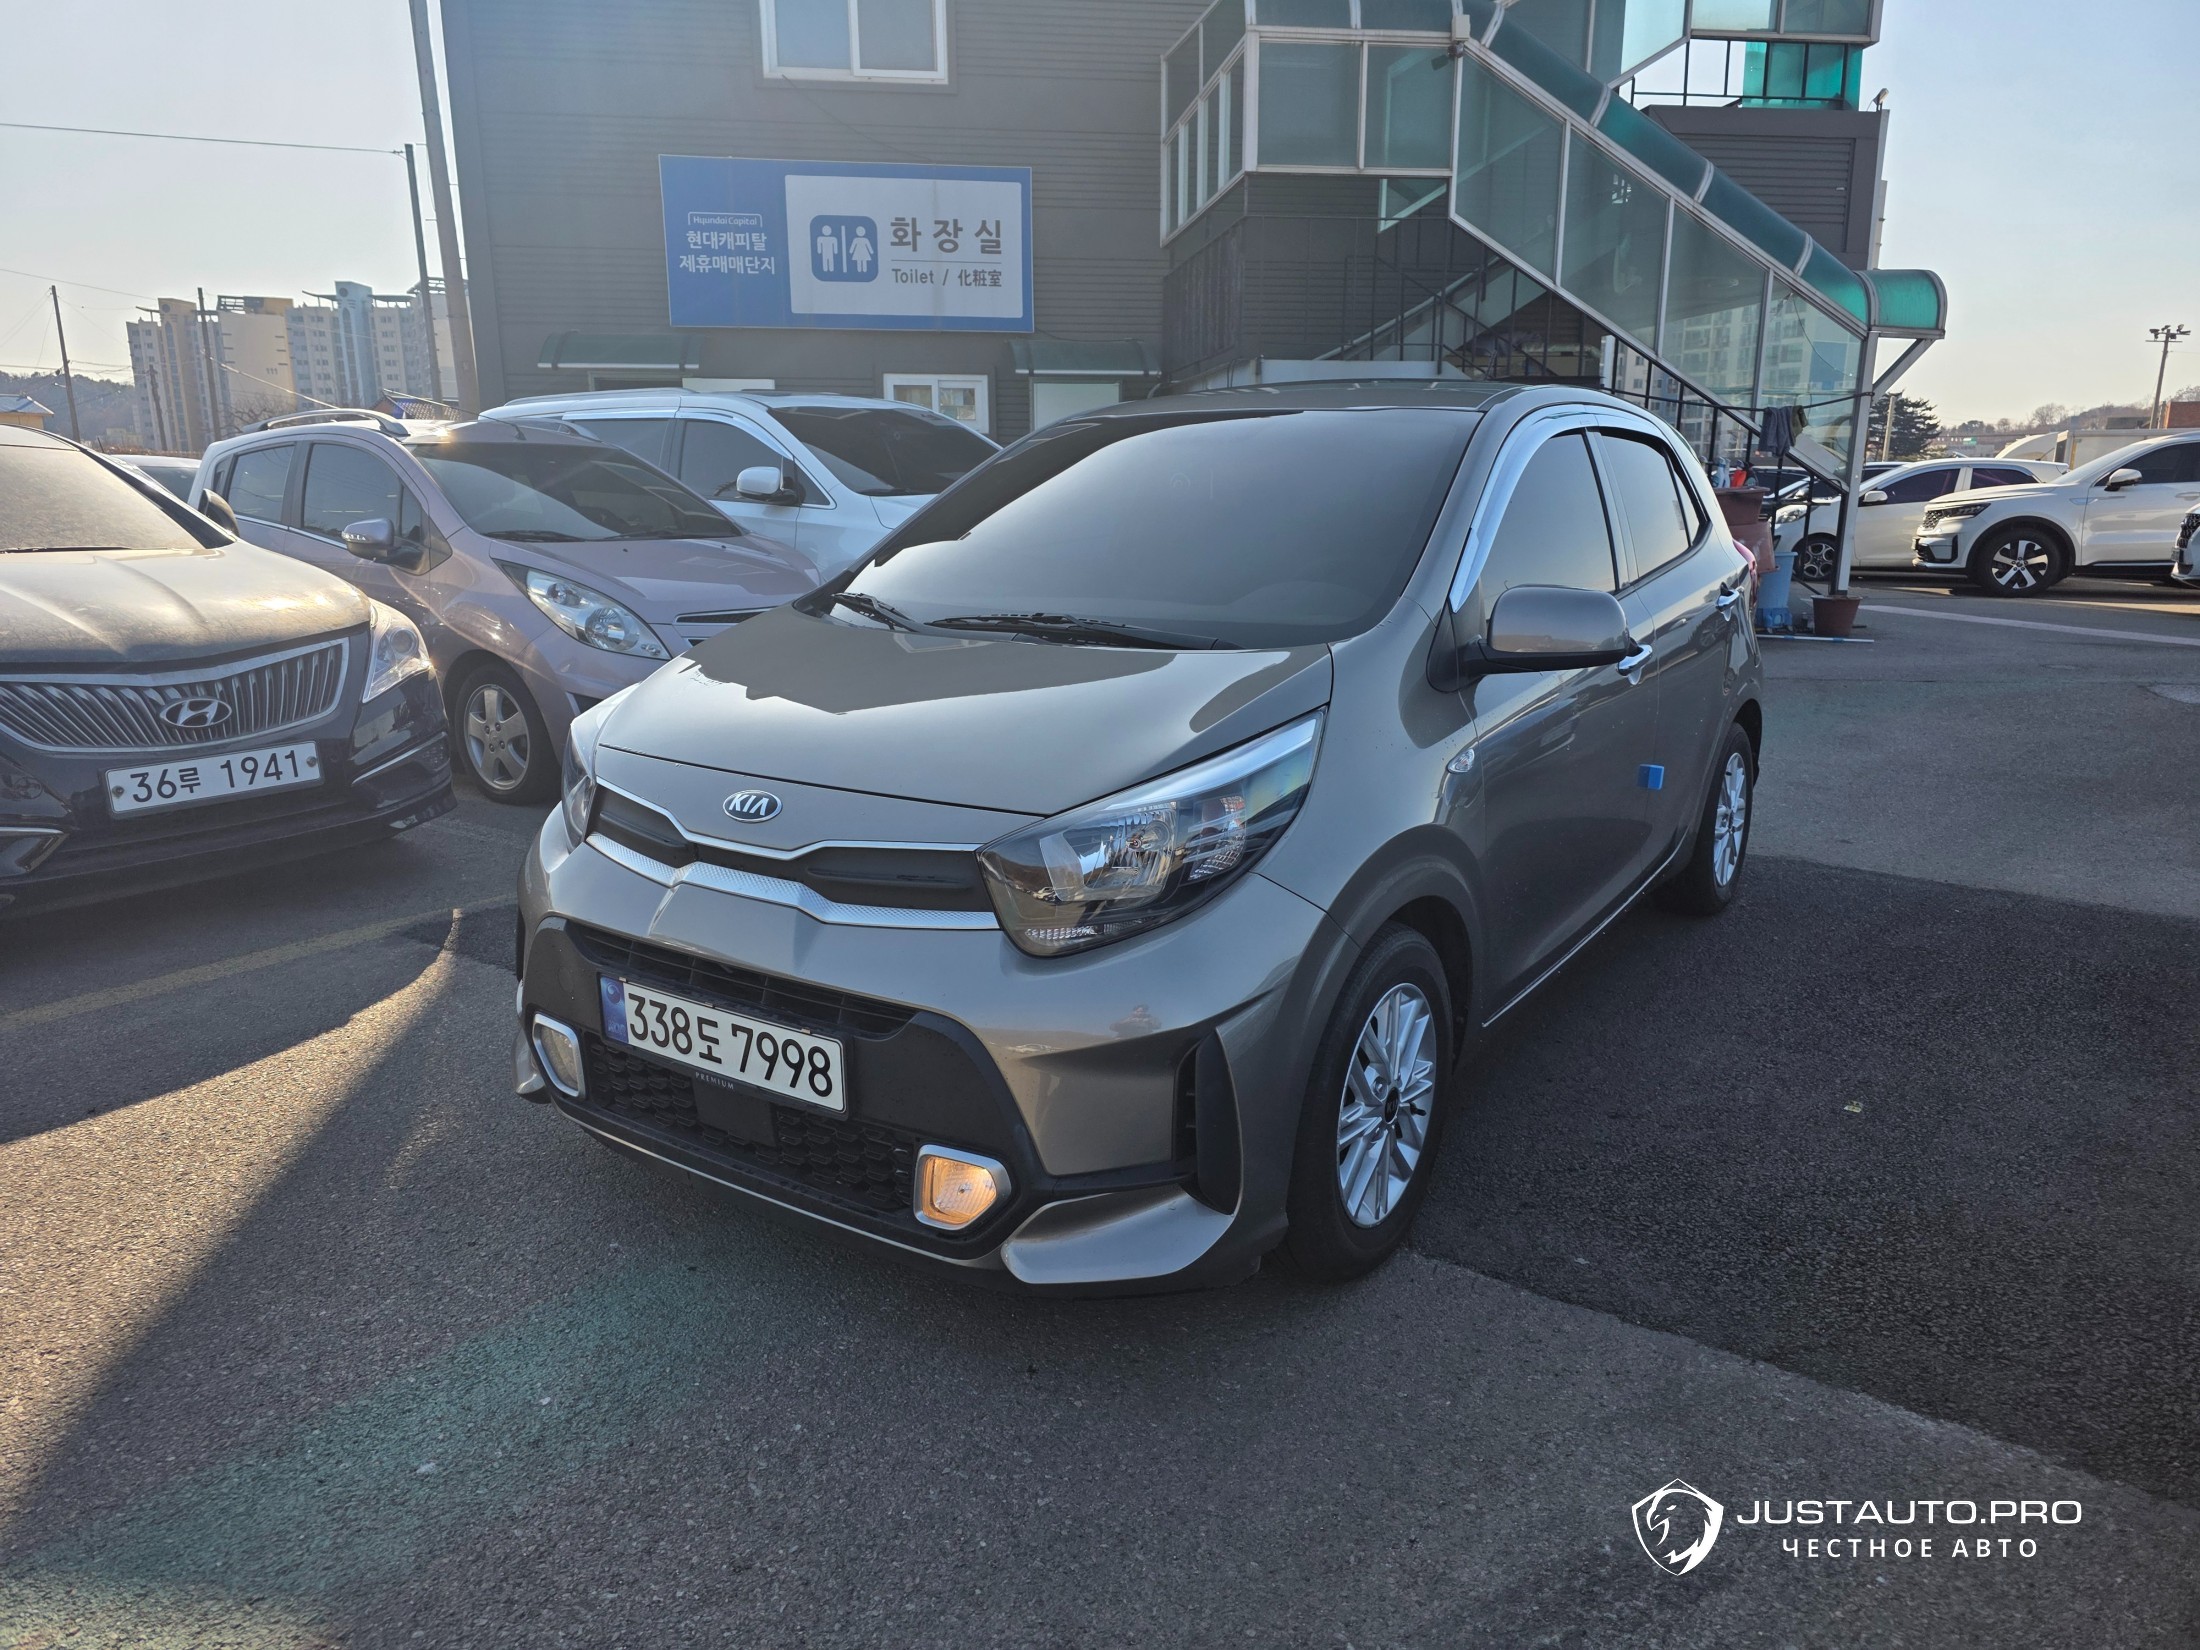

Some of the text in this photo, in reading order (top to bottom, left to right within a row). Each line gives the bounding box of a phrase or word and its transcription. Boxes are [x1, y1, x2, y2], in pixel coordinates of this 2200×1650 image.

[693, 215, 757, 227] Hyundai Capital
[686, 230, 767, 251] 현대캐피탈
[890, 217, 1002, 254] 화장실
[679, 254, 775, 275] 제휴매매단지
[891, 268, 934, 284] Toilet
[957, 269, 1002, 287] 化粧室
[130, 750, 299, 803] 36루 1941
[728, 793, 769, 816] KIA
[627, 992, 833, 1098] 338도 7998
[695, 1071, 734, 1090] PREMIUM
